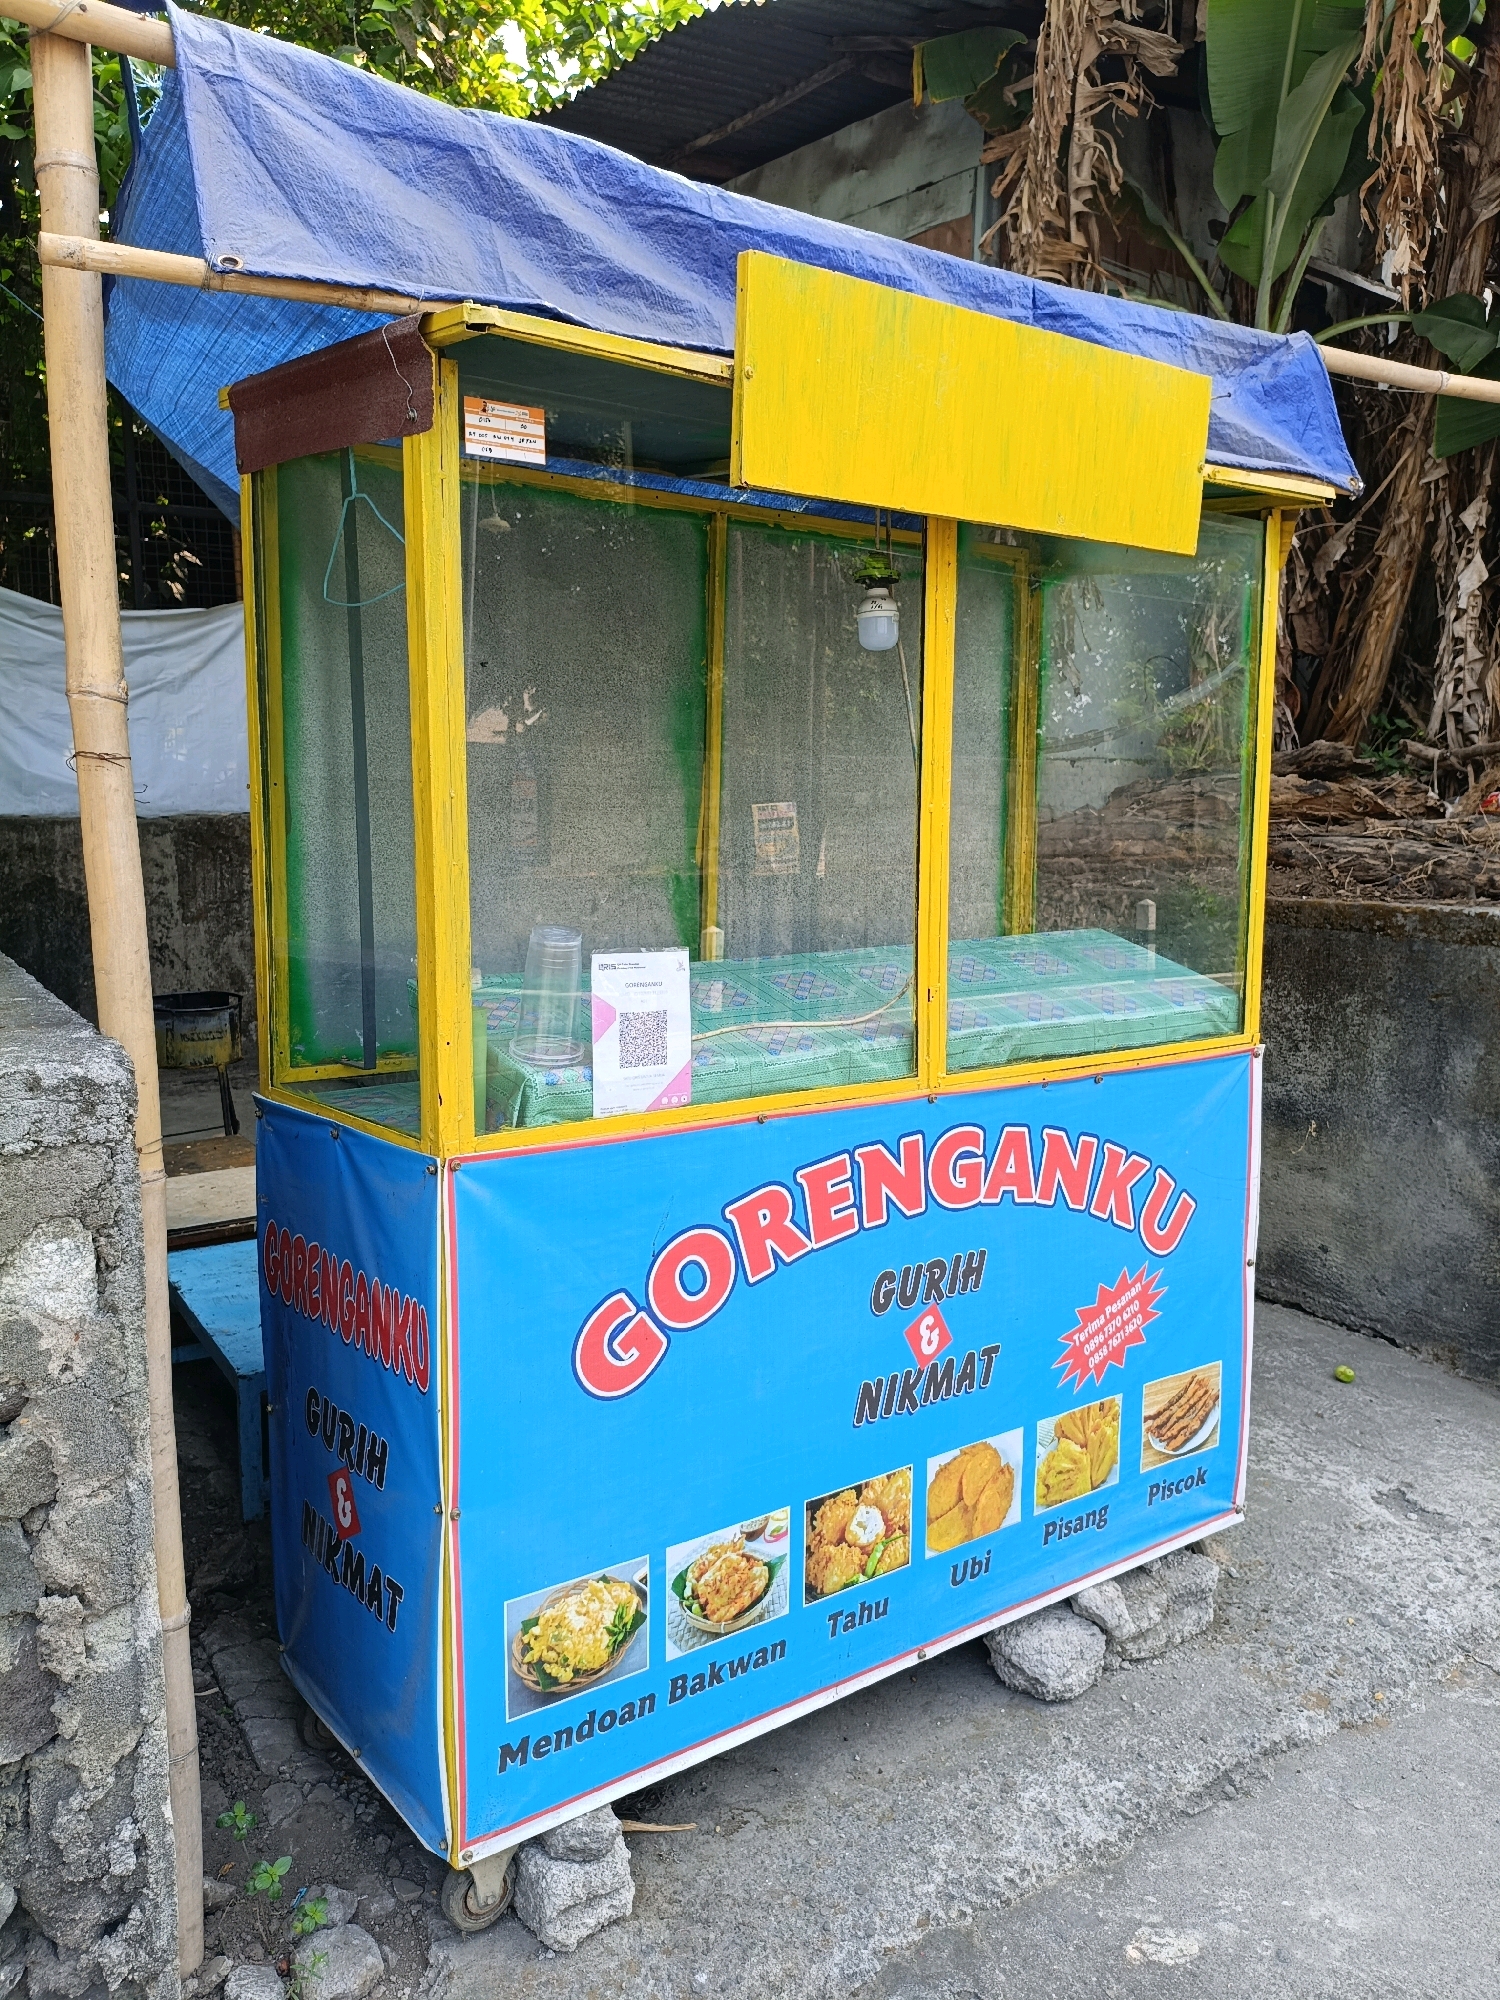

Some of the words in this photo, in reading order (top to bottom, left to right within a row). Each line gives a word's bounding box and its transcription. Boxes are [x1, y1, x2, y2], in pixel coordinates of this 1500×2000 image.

[571, 1124, 1197, 1401] GORENGANKU
[870, 1247, 988, 1317] GURIH
[264, 1219, 431, 1394] GORENGANKU
[918, 1316, 941, 1356] &
[1072, 1314, 1105, 1347] Terima
[1104, 1282, 1142, 1319] Pesanan
[1083, 1332, 1105, 1356] 0896
[1103, 1315, 1122, 1339] 7370
[1122, 1299, 1140, 1321] 6210
[1088, 1345, 1109, 1369] 0858
[1107, 1329, 1125, 1352] 7621
[1124, 1313, 1143, 1337] 3620
[852, 1343, 1001, 1427] NIKMAT
[305, 1386, 389, 1491] GURIH
[335, 1477, 353, 1530] &
[1146, 1464, 1209, 1507] Piscok
[1041, 1502, 1110, 1548] Pisang
[302, 1498, 405, 1634] NIKMAT
[949, 1549, 992, 1589] Ubi
[826, 1594, 890, 1641] Tahu
[496, 1691, 657, 1776] Mendoan
[667, 1636, 788, 1706] Bakwan
